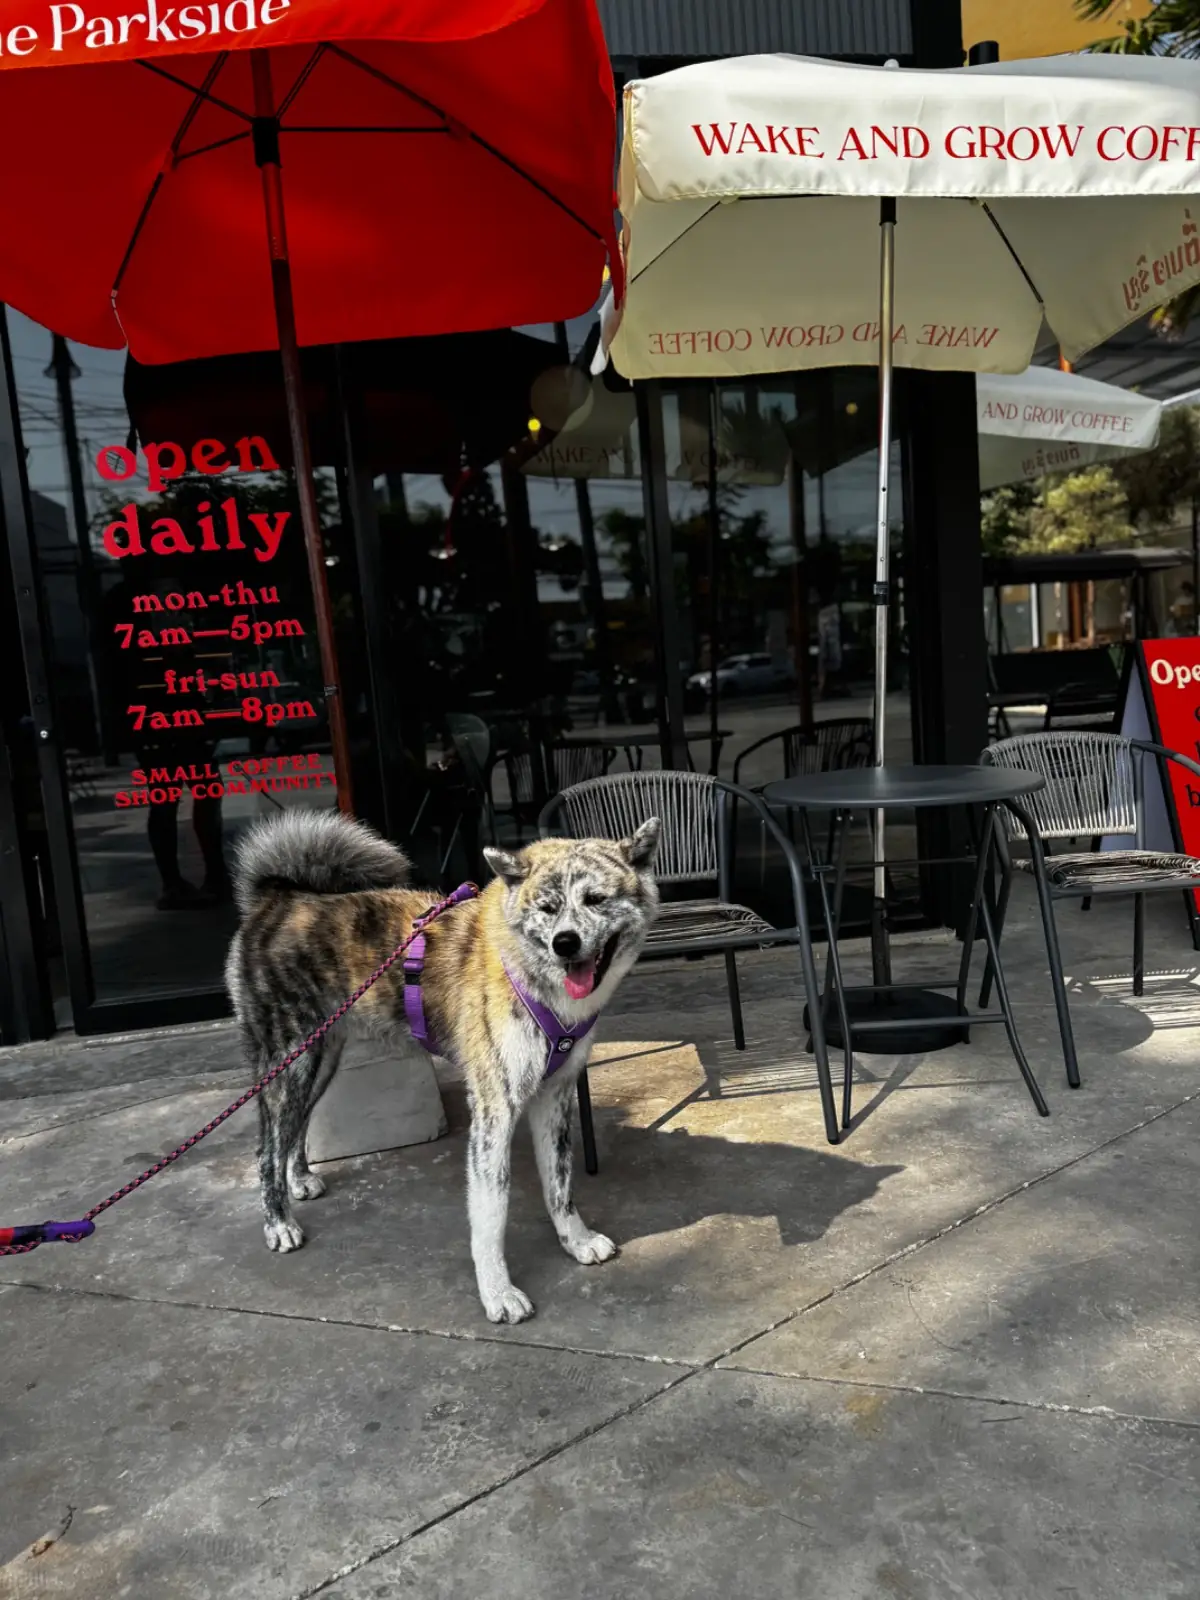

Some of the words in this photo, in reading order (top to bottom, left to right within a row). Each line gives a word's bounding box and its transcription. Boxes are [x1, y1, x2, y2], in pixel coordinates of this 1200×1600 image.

[0, 24, 38, 57] e
[50, 0, 291, 52] Parkside
[691, 122, 825, 159] WAKE
[838, 125, 930, 161] AND
[944, 124, 1084, 161] GROW
[1096, 125, 1200, 162] COFF
[982, 401, 1018, 420] AND
[1023, 404, 1069, 425] GROW
[1071, 410, 1133, 432] COFFEE
[96, 435, 280, 492] open
[102, 497, 291, 562] daily
[132, 581, 280, 613] mon-thu
[164, 669, 280, 695] fri-sun
[131, 763, 219, 786] SMALL
[227, 753, 323, 777] COFFEE
[115, 787, 183, 808] SHOP
